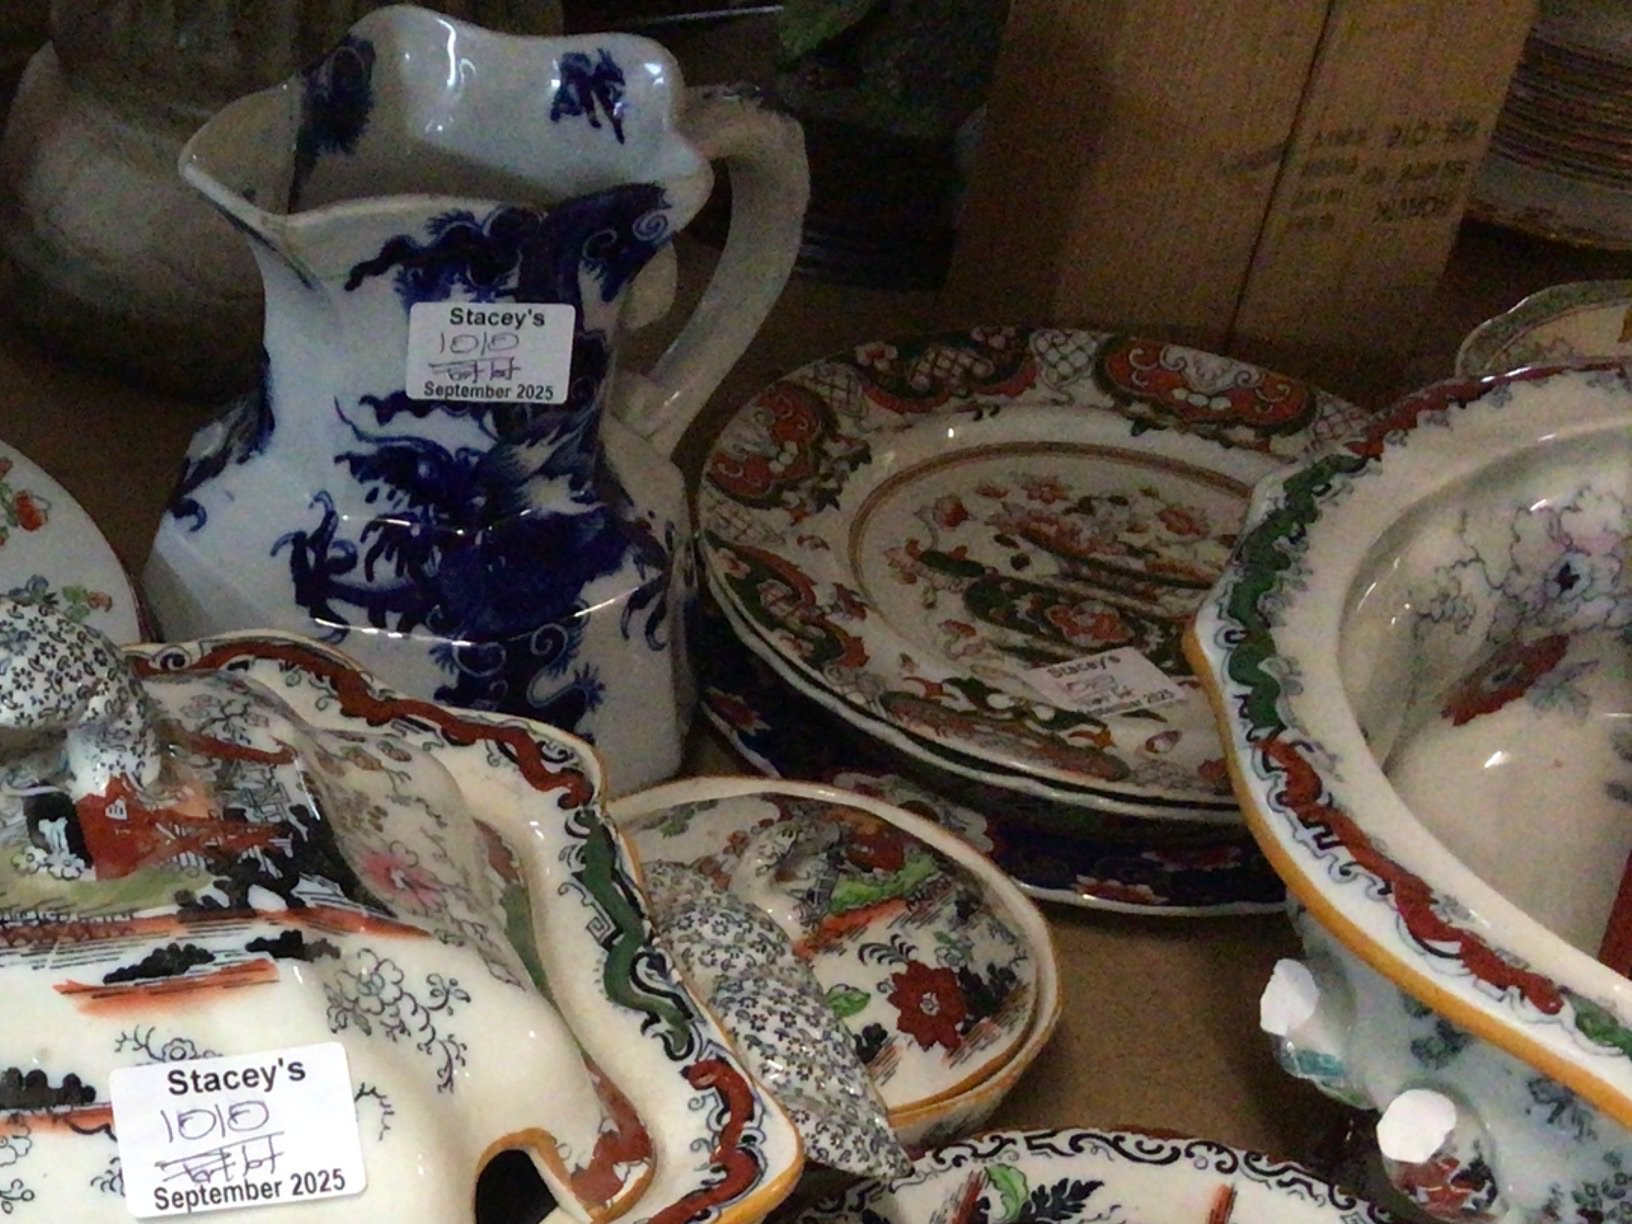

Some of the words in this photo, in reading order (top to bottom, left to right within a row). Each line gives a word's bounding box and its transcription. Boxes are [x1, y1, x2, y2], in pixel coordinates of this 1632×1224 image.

[450, 307, 546, 330] Stacey's
[424, 381, 512, 399] September
[518, 383, 554, 400] 2025
[167, 1057, 306, 1096] Stacey's
[154, 1179, 283, 1213] September
[290, 1168, 346, 1197] 2025
